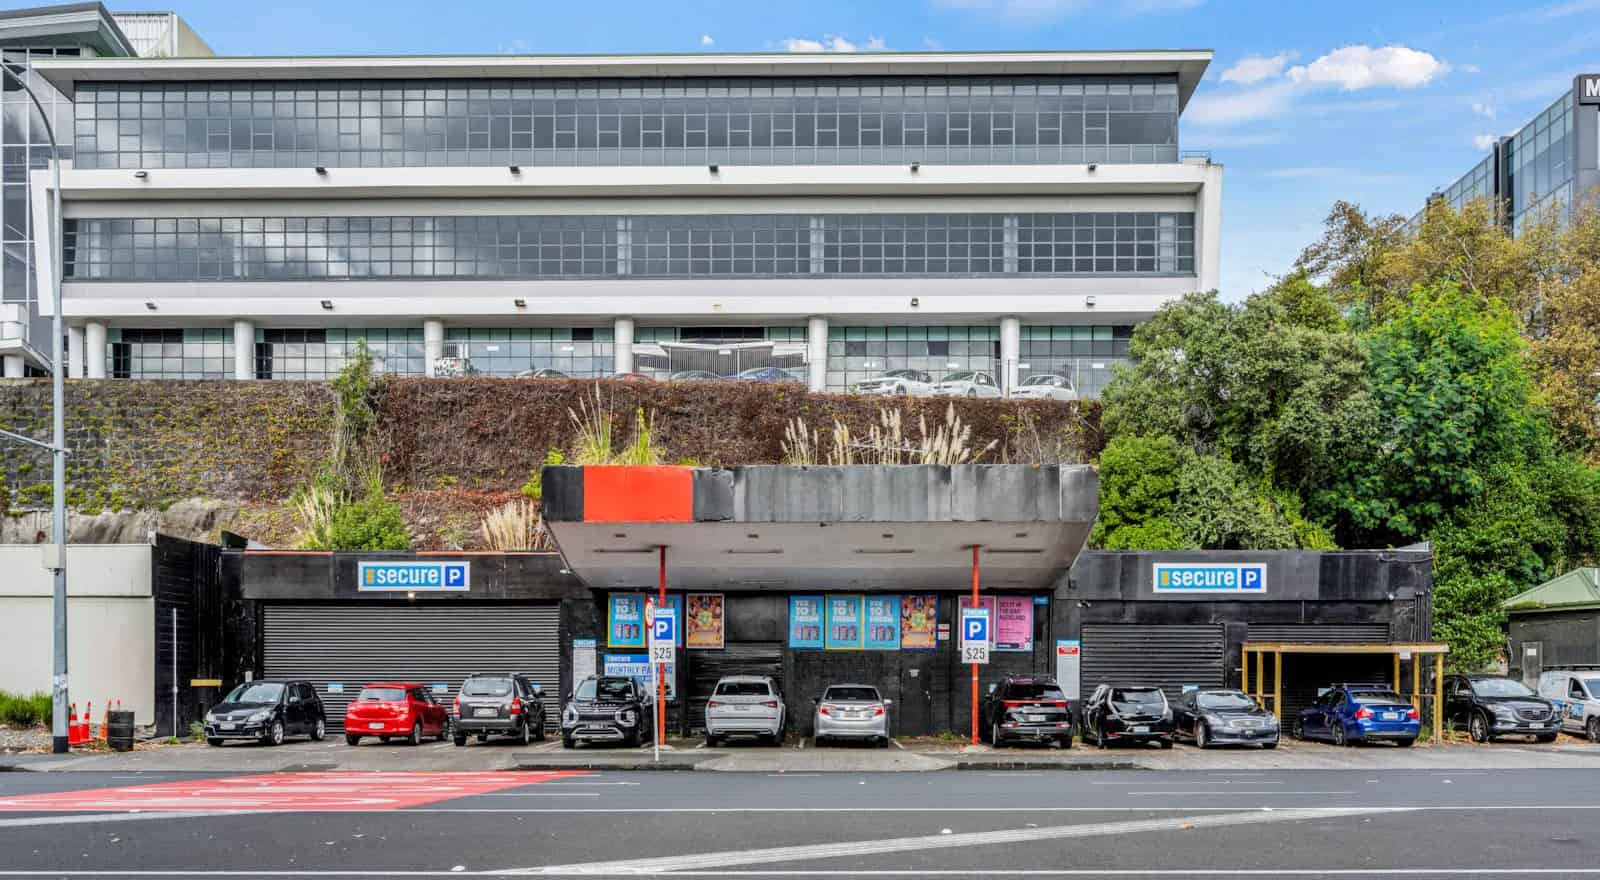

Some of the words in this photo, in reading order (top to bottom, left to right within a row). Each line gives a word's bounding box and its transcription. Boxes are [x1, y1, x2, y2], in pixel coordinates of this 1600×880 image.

[376, 568, 439, 584] secure
[449, 568, 461, 584] P
[1171, 571, 1235, 586] secure
[1245, 571, 1257, 586] P
[656, 621, 668, 637] P
[969, 621, 982, 638] P
[966, 648, 985, 660] $25
